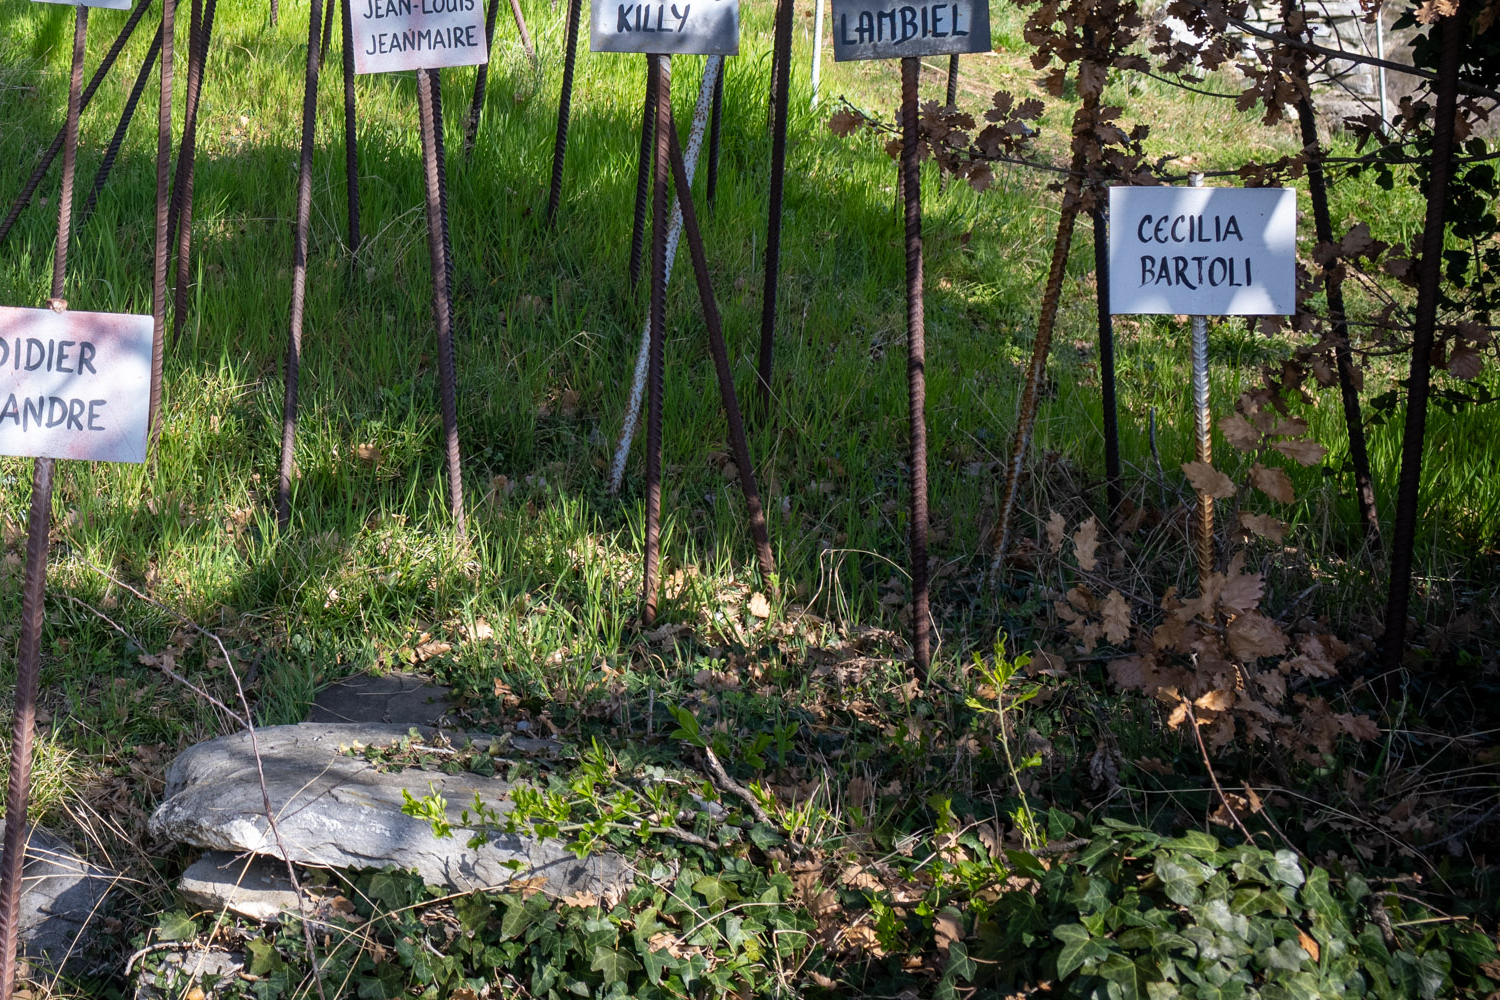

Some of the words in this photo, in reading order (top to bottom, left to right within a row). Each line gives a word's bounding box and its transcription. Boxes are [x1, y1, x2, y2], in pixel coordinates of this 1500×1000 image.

[616, 3, 691, 33] KILLY
[839, 3, 971, 47] LAMBIEL
[365, 25, 479, 56] JEANMAIRE
[1136, 213, 1244, 244] CECILIA
[1138, 255, 1253, 291] BARTOLI
